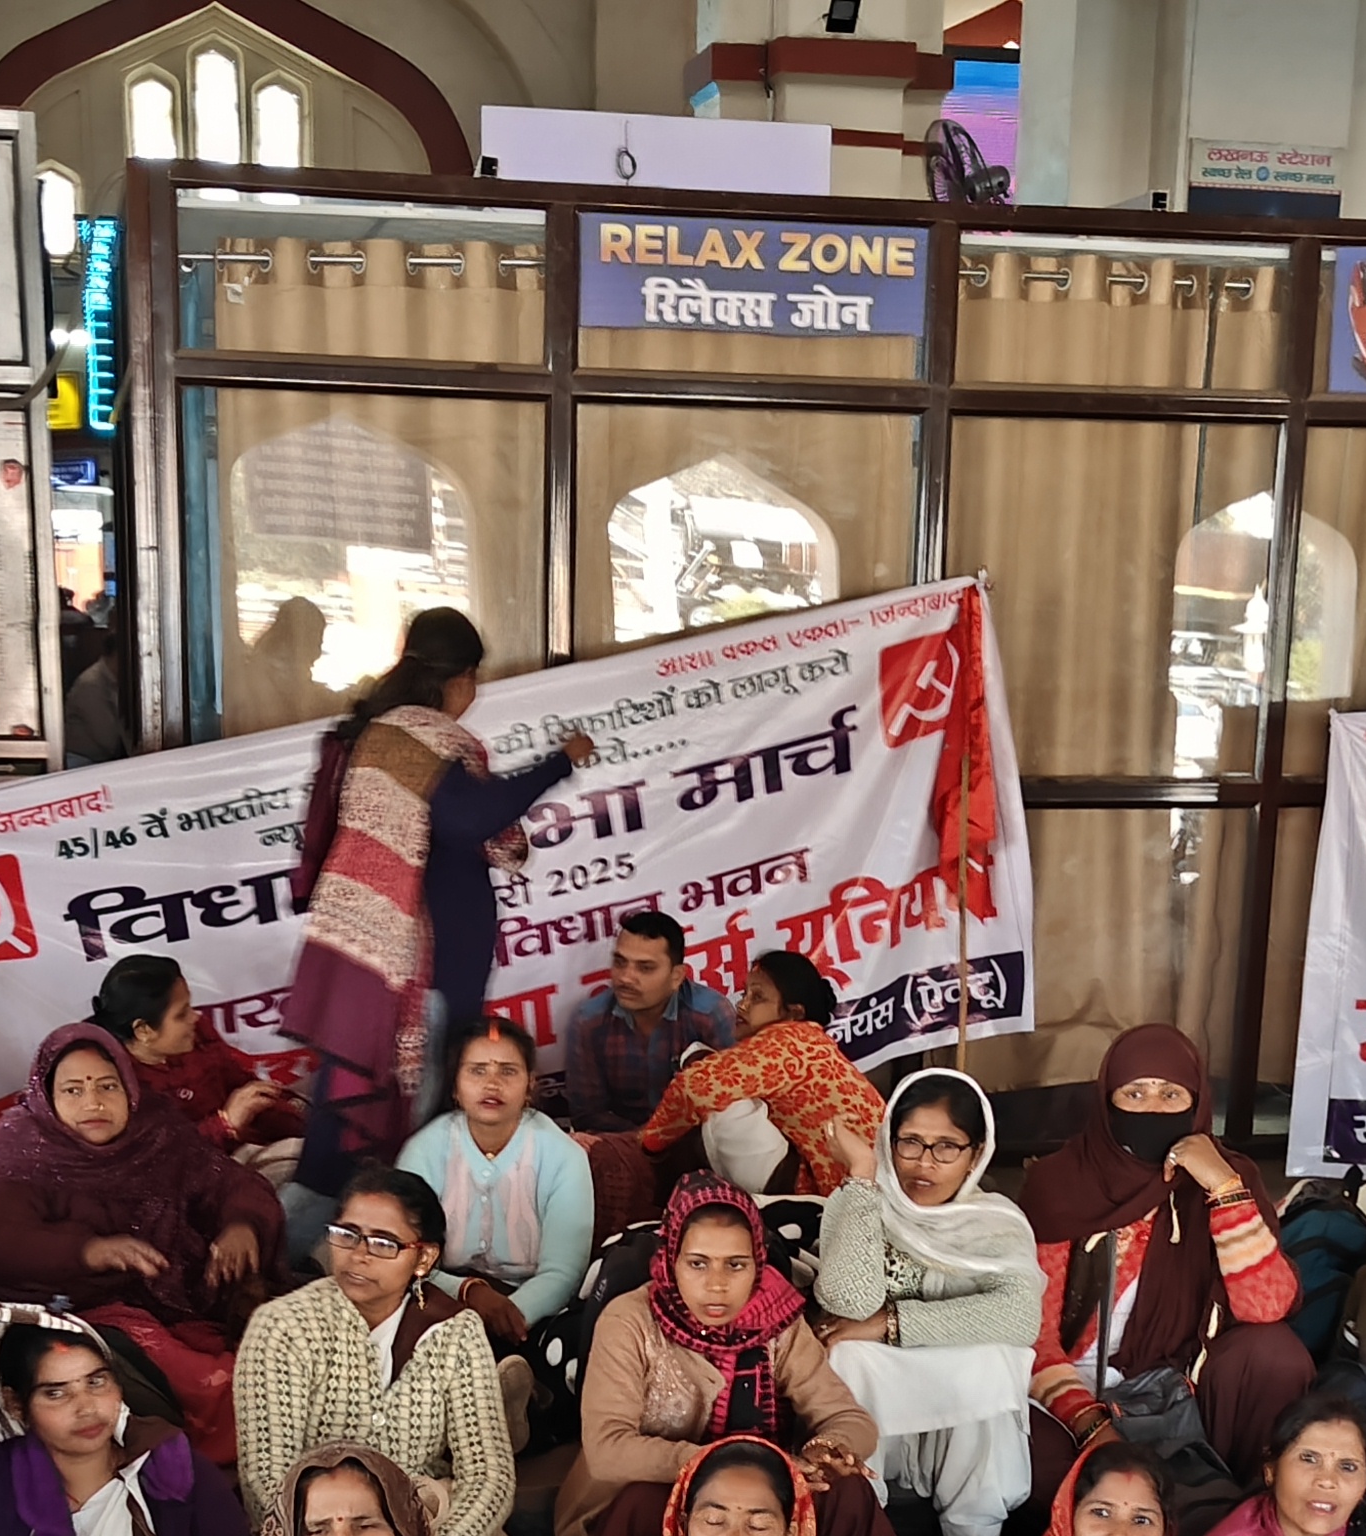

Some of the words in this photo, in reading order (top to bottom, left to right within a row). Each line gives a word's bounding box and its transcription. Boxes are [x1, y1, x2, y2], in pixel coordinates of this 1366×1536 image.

[1207, 148, 1269, 162] लखनऊ
[1276, 149, 1332, 167] स्टेशन
[600, 222, 765, 271] RELAX
[778, 231, 916, 276] ZONE
[641, 276, 778, 328] रिलैक्स
[787, 284, 874, 332] जोन
[669, 704, 858, 811] मार्च
[55, 827, 137, 859] 45/46
[544, 852, 638, 897] 2025
[678, 848, 810, 913] भवन
